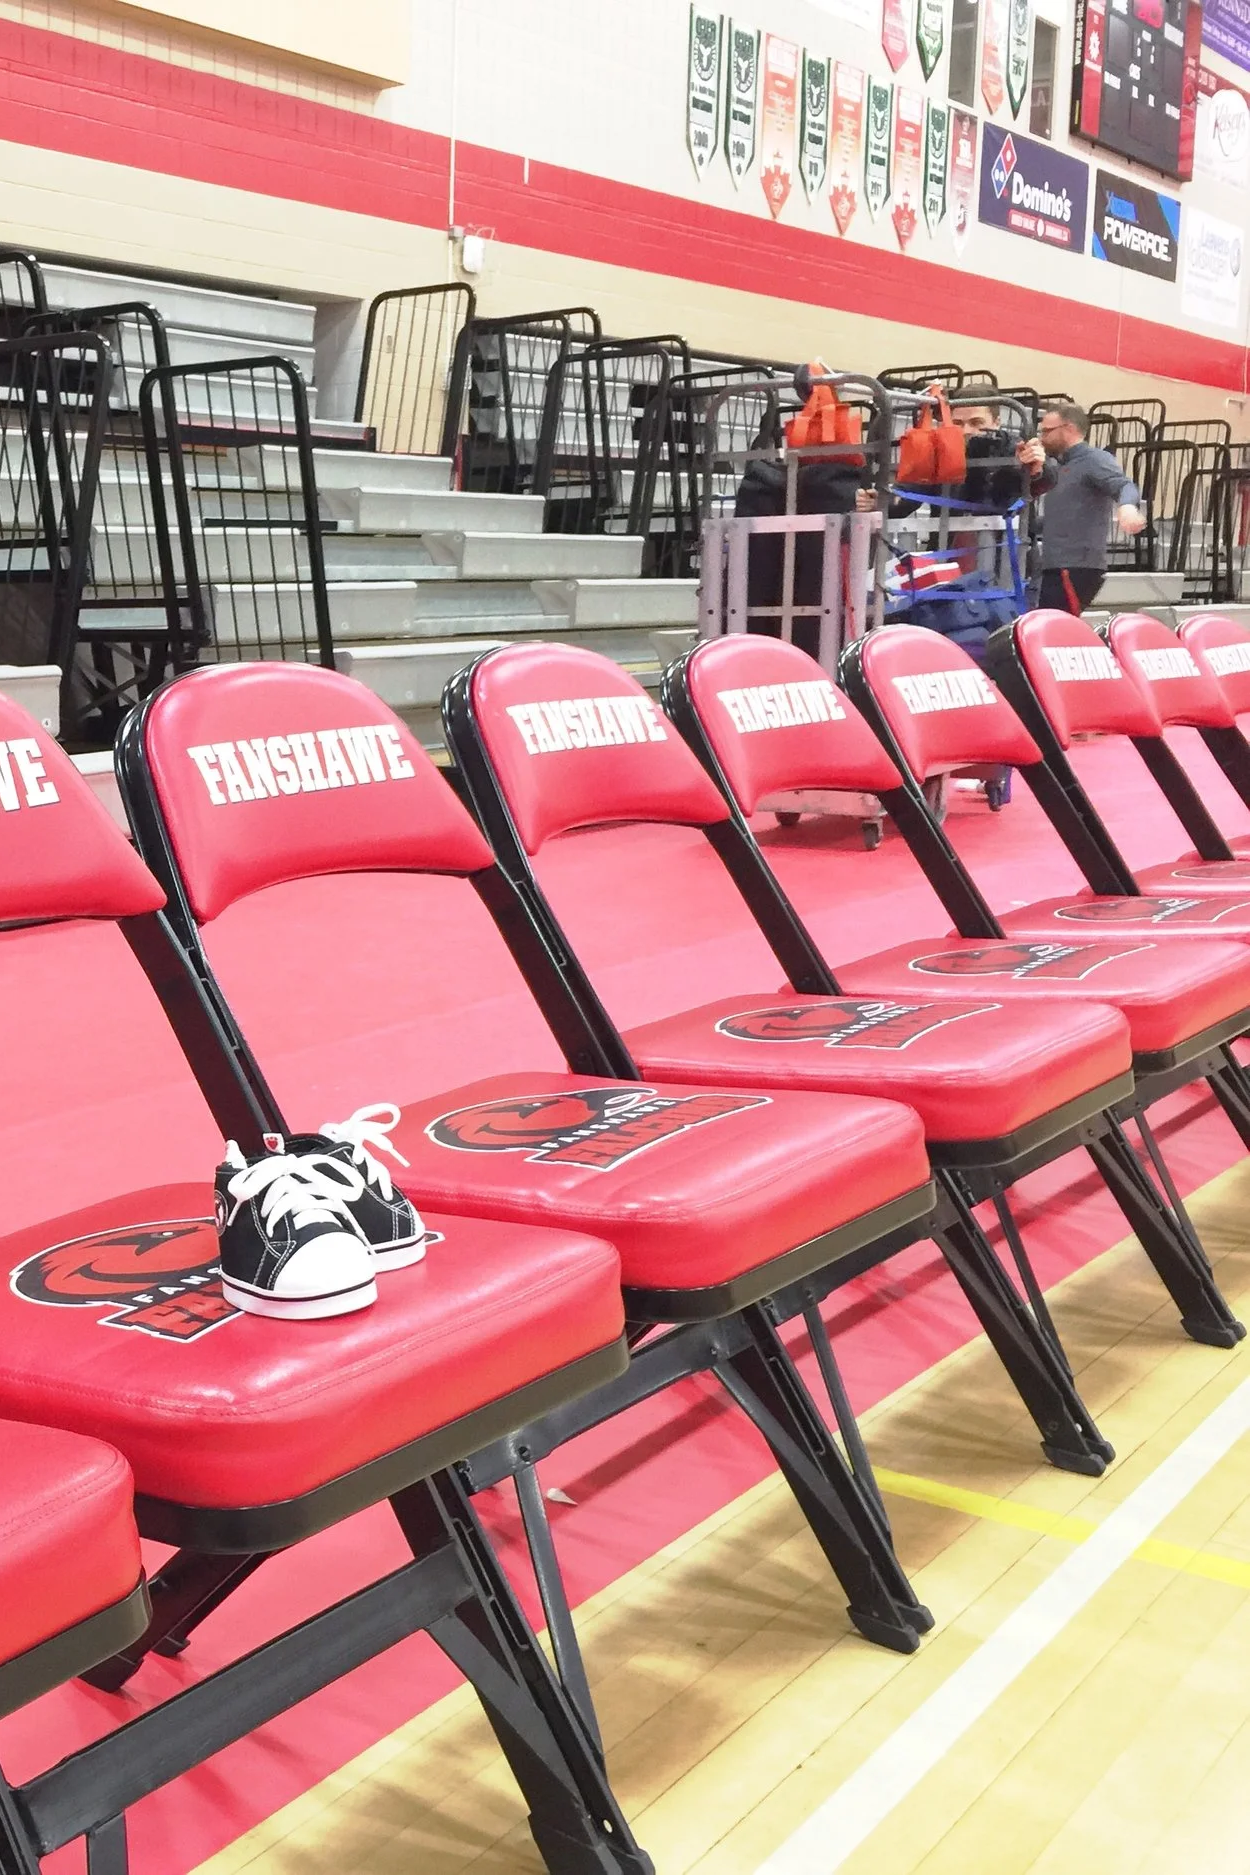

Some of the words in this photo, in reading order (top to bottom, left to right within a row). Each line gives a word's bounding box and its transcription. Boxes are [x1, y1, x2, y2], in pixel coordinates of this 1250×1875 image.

[1011, 171, 1072, 222] Domino's
[1103, 216, 1171, 262] POWERADE
[717, 679, 846, 734] FANSHAWE
[891, 668, 997, 715] FANSHAWE
[505, 695, 668, 755] FANSHAWE
[187, 724, 415, 806] FANSHAWE
[540, 1099, 676, 1149] FANSHAWE
